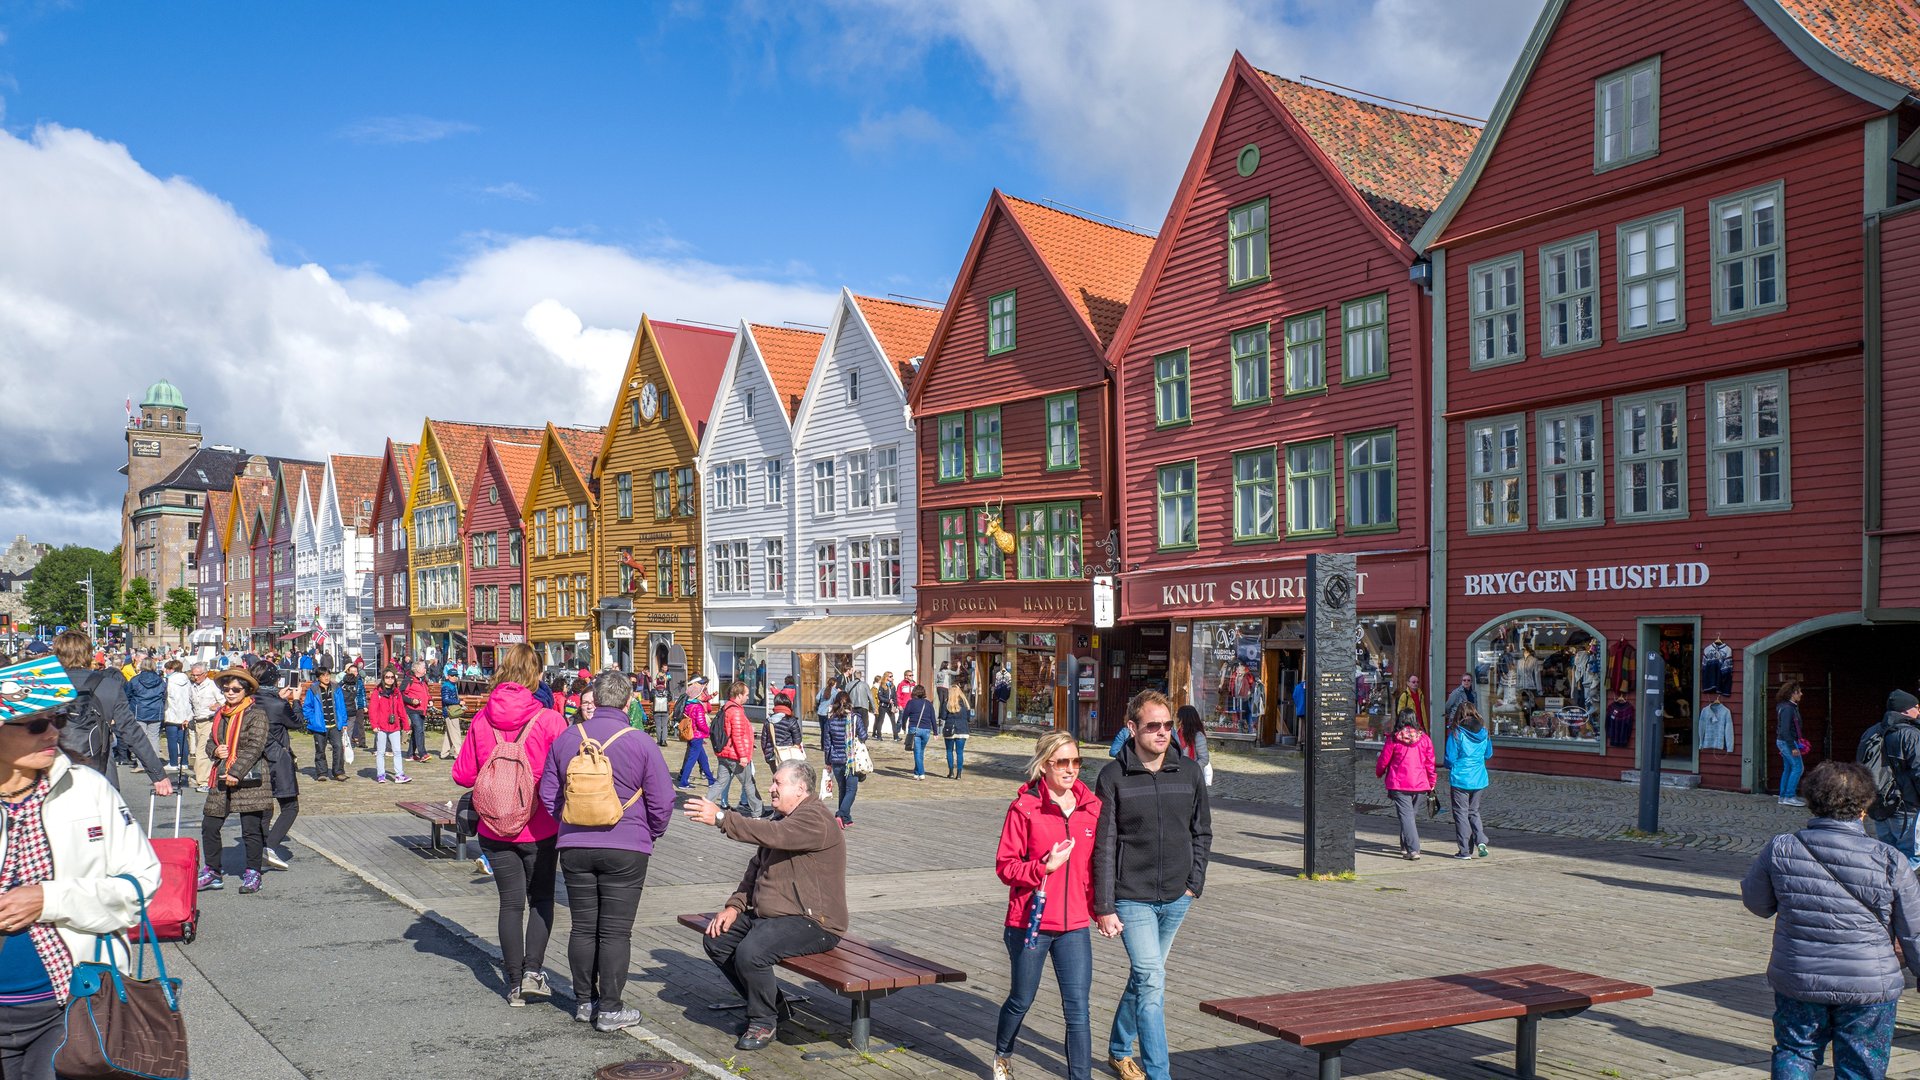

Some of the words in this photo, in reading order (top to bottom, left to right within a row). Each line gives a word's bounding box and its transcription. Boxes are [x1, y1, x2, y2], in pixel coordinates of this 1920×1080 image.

[1162, 582, 1217, 605] KNUT
[1230, 573, 1369, 600] SKURTT
[1464, 569, 1578, 596] BRYGGEN
[1586, 562, 1710, 591] HUSFLID
[932, 597, 998, 612] BRYGGEN
[1023, 596, 1088, 611] HANDEL
